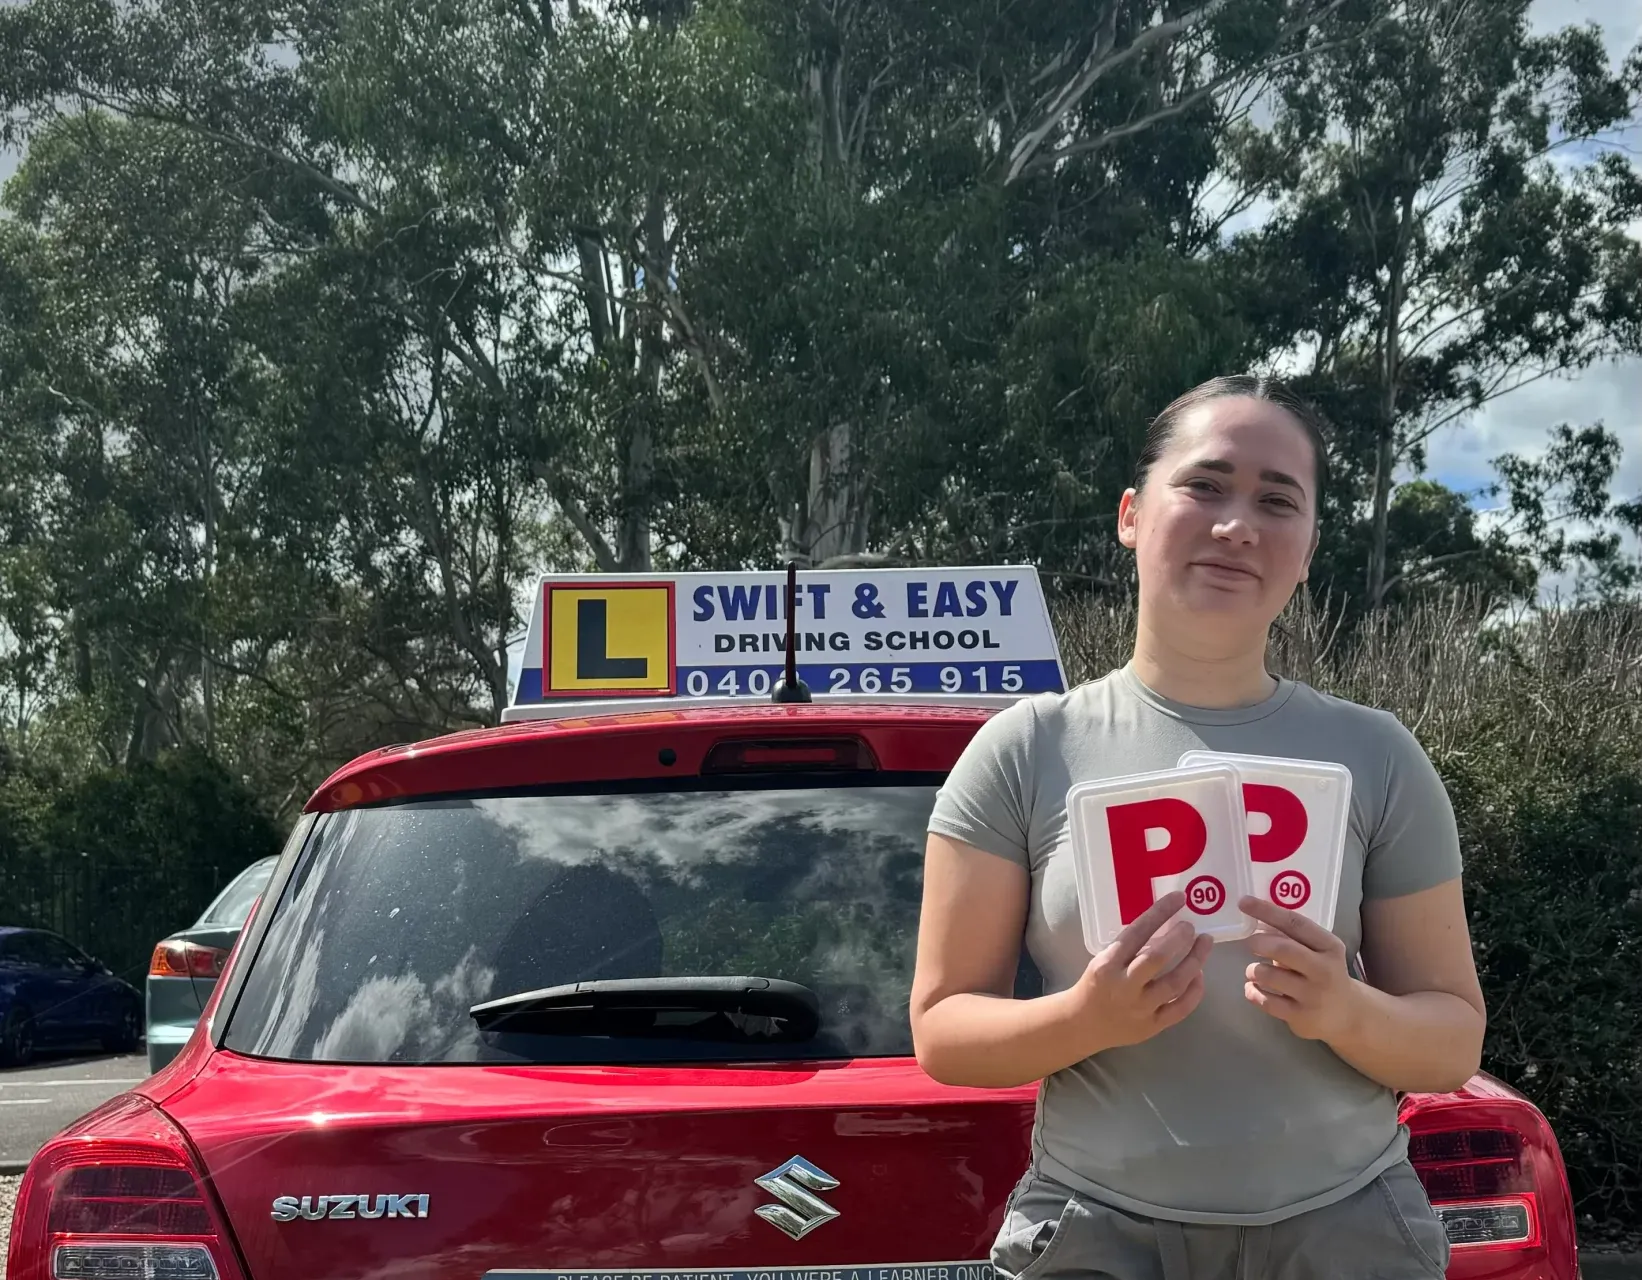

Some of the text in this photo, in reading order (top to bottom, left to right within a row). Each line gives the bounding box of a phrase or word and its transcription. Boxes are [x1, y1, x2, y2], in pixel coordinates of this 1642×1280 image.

[693, 580, 1019, 621] SWIFT & EASY
[577, 598, 648, 679] L
[715, 630, 1000, 653] DRIVING SCHOOL
[686, 665, 1023, 697] 040 265 915
[1106, 798, 1207, 926] P
[1193, 886, 1217, 904] 90
[1278, 881, 1302, 898] 90
[270, 1194, 430, 1222] SUZUKI
